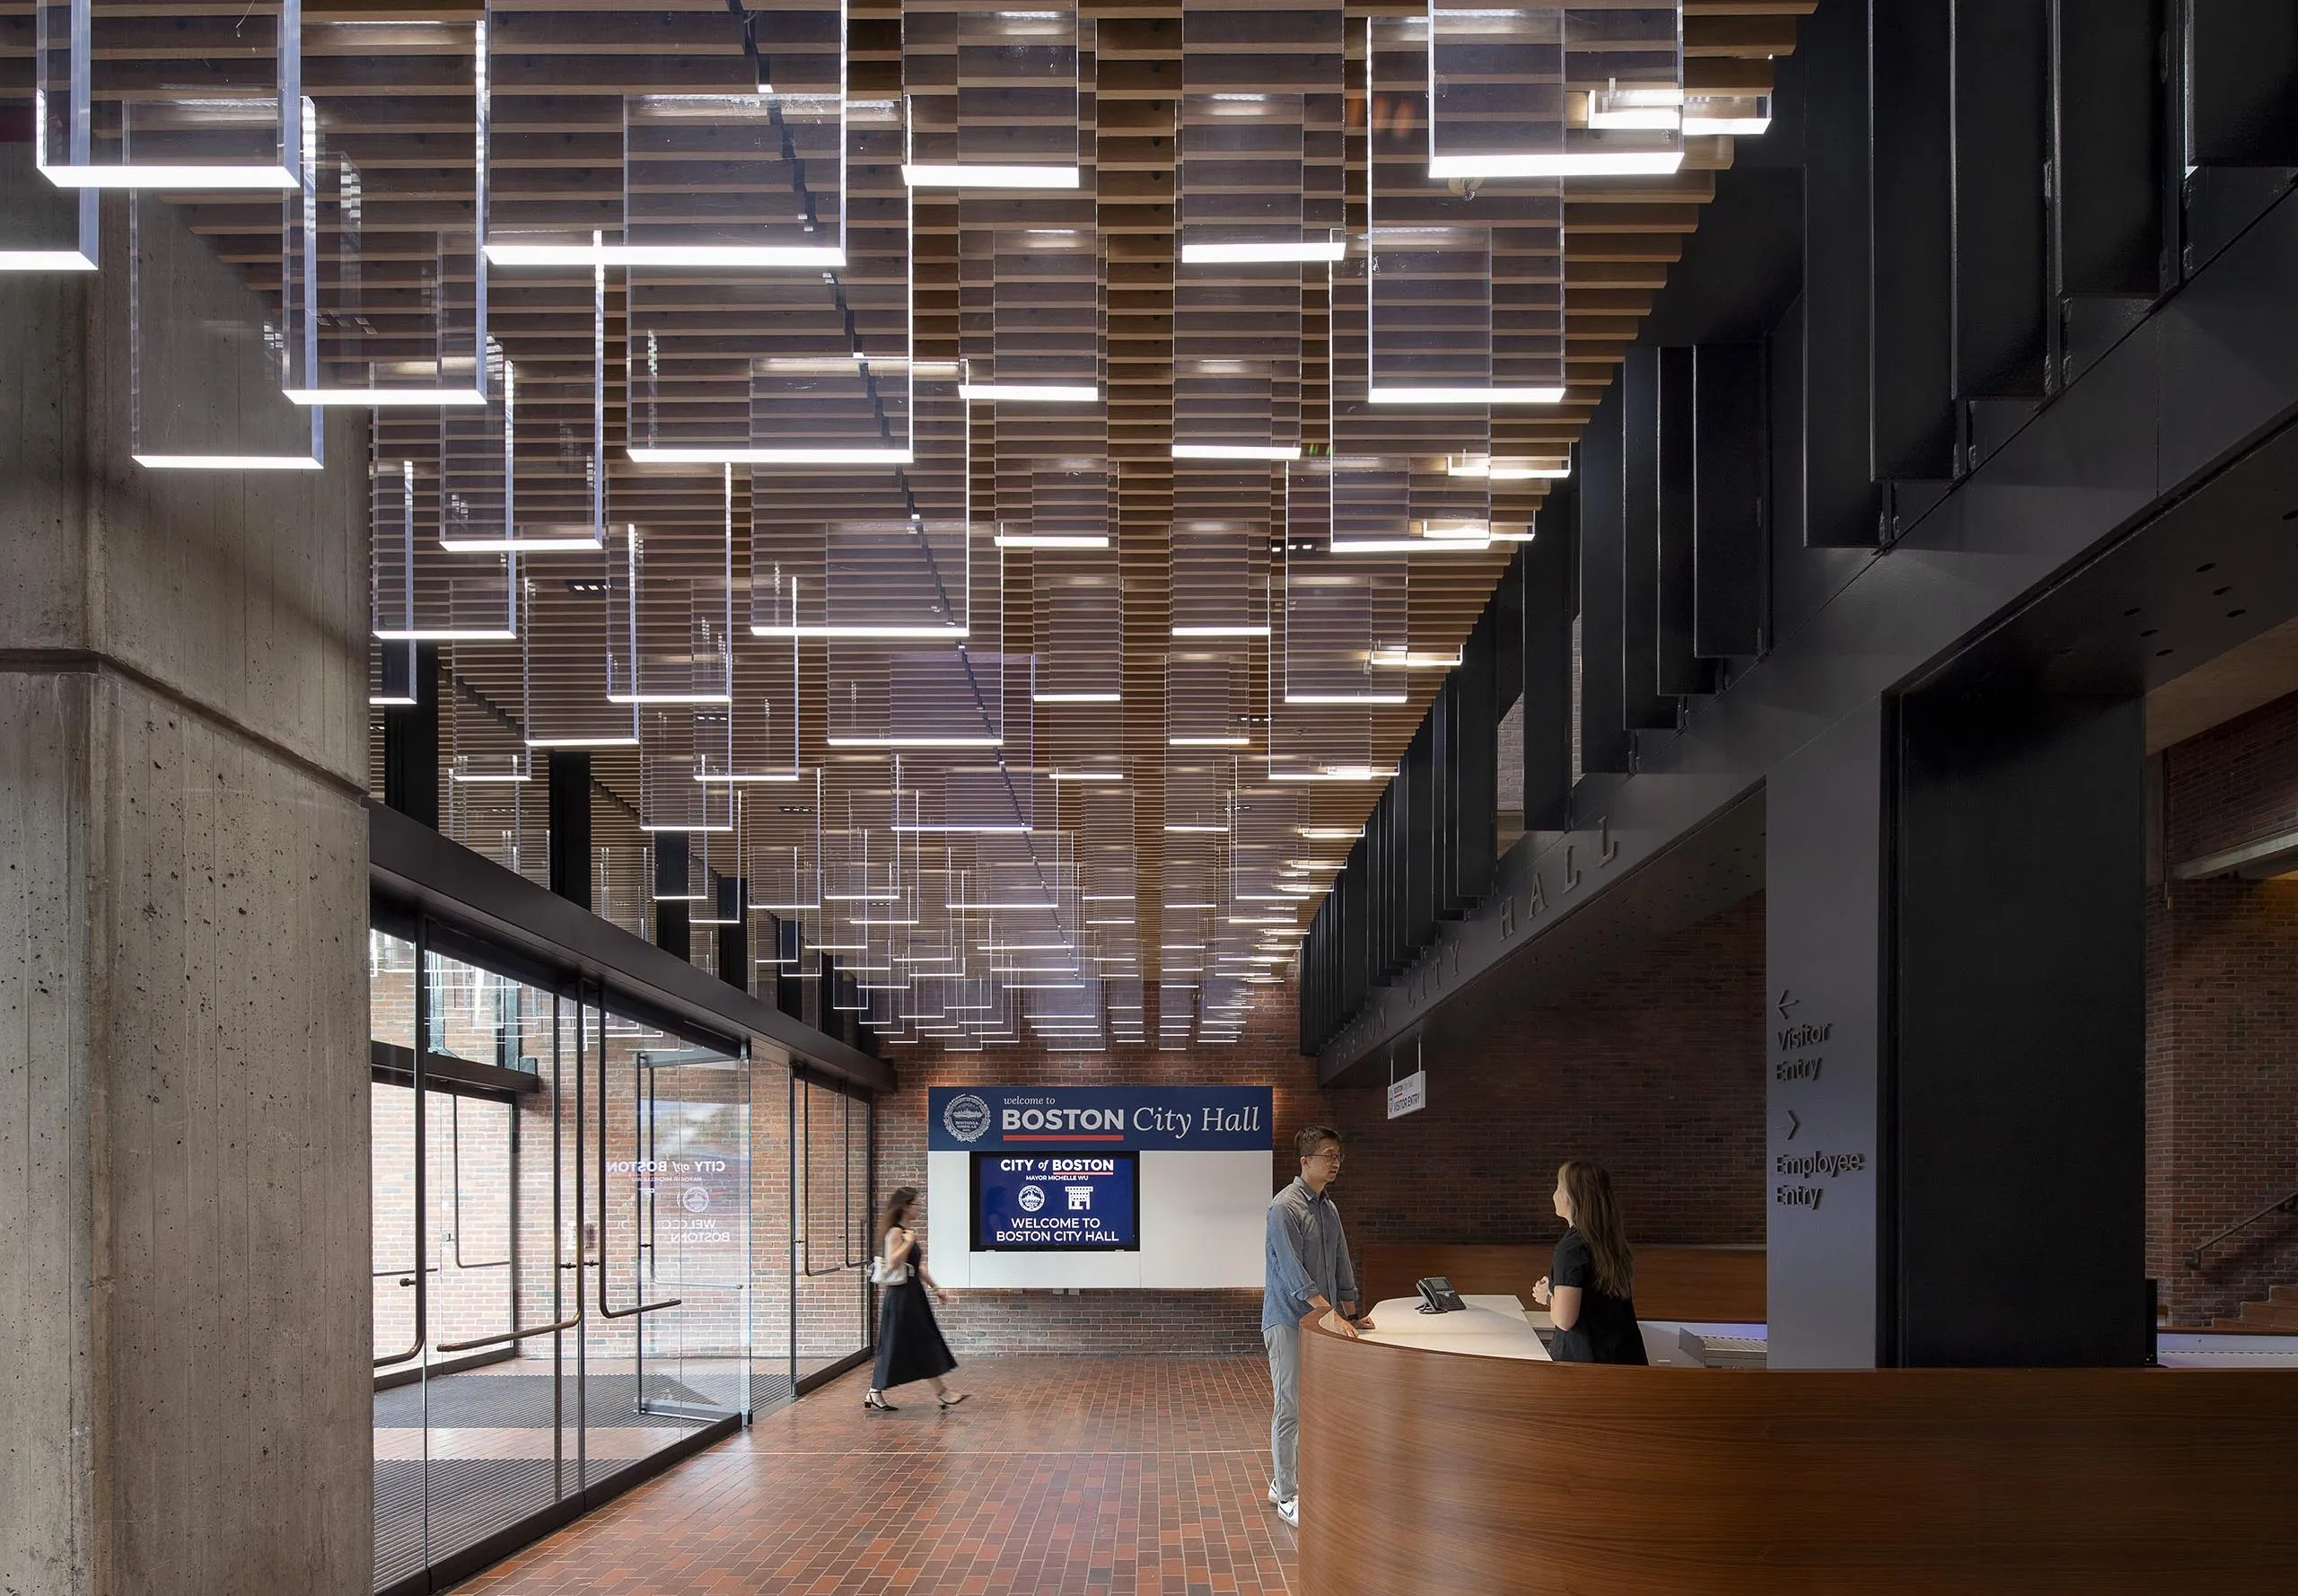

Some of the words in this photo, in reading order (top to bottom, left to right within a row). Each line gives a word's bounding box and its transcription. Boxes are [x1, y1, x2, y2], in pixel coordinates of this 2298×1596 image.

[1407, 939, 1463, 1009] CITY
[1497, 815, 1619, 941] HALL
[1777, 1022, 1832, 1051] Visitor
[1776, 1057, 1823, 1082] Entry
[1004, 1096, 1044, 1105] welcome
[1046, 1097, 1056, 1105] to
[1002, 1109, 1124, 1130] BOSTON
[1133, 1107, 1192, 1139] City
[1201, 1106, 1260, 1132] Hall
[1000, 1159, 1034, 1171] CITY
[1038, 1160, 1049, 1171] of
[1052, 1159, 1114, 1171] BOSTON
[1776, 1150, 1865, 1179] Employee
[1776, 1184, 1824, 1210] Entry
[1011, 1217, 1080, 1229] WELCOME
[1082, 1217, 1101, 1229] TO
[996, 1231, 1051, 1241] BOSTON
[1053, 1231, 1083, 1241] CITY
[1085, 1231, 1119, 1241] HALL
